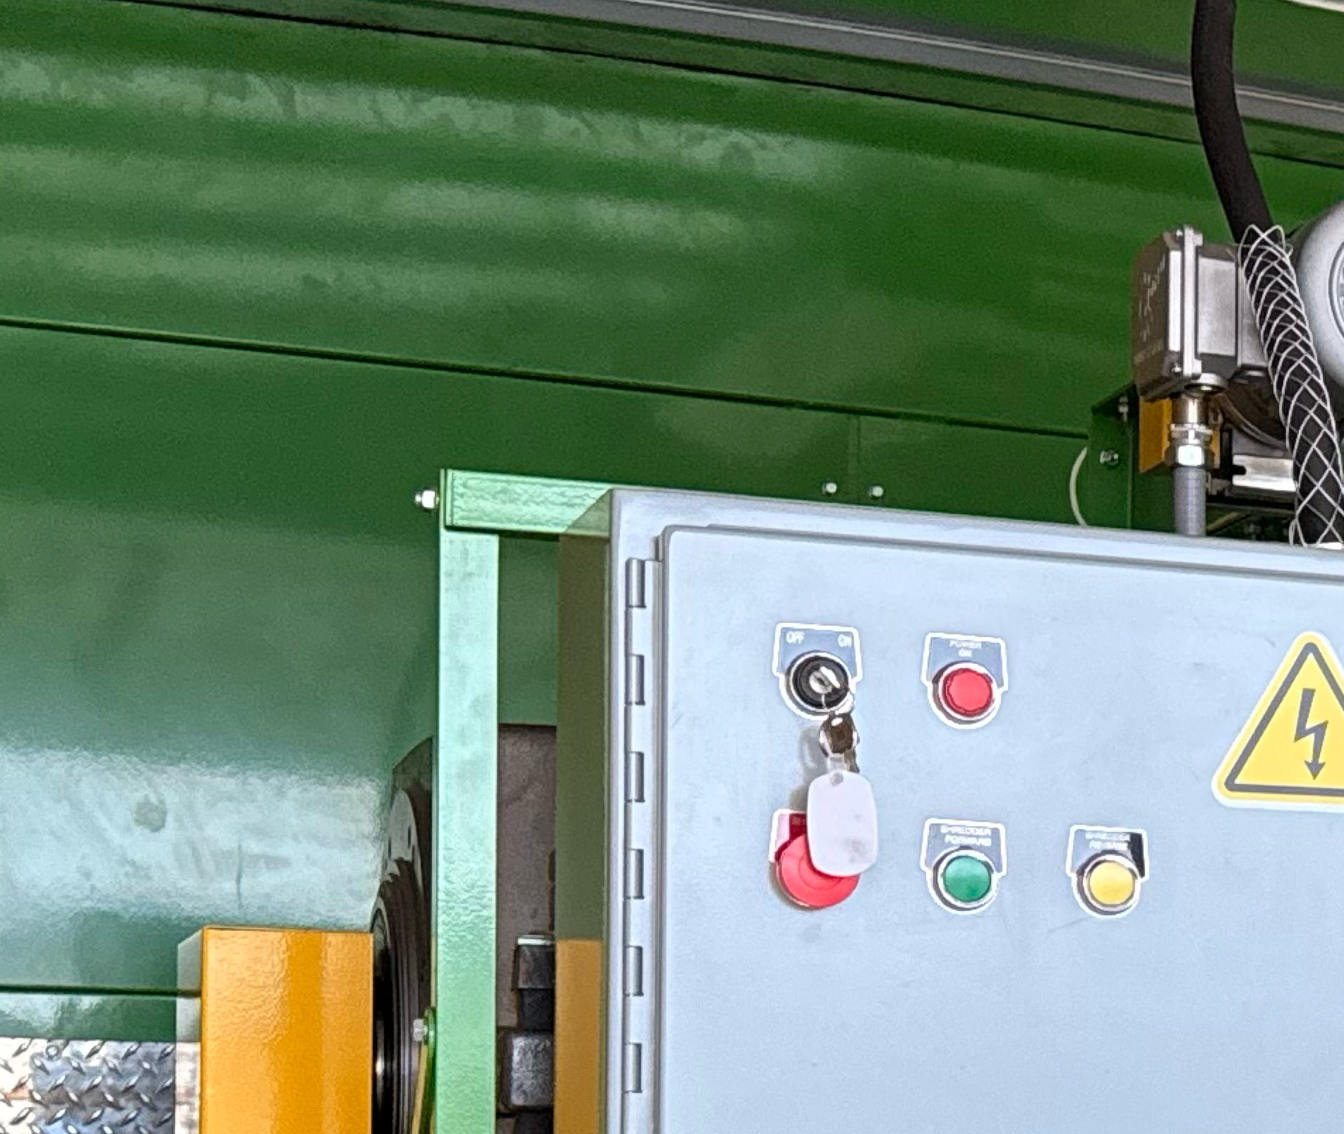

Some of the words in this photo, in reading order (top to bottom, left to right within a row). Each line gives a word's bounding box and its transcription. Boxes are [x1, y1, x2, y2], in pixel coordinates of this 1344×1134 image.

[786, 630, 805, 644] OFF
[837, 632, 852, 647] ON
[958, 648, 973, 658] ON
